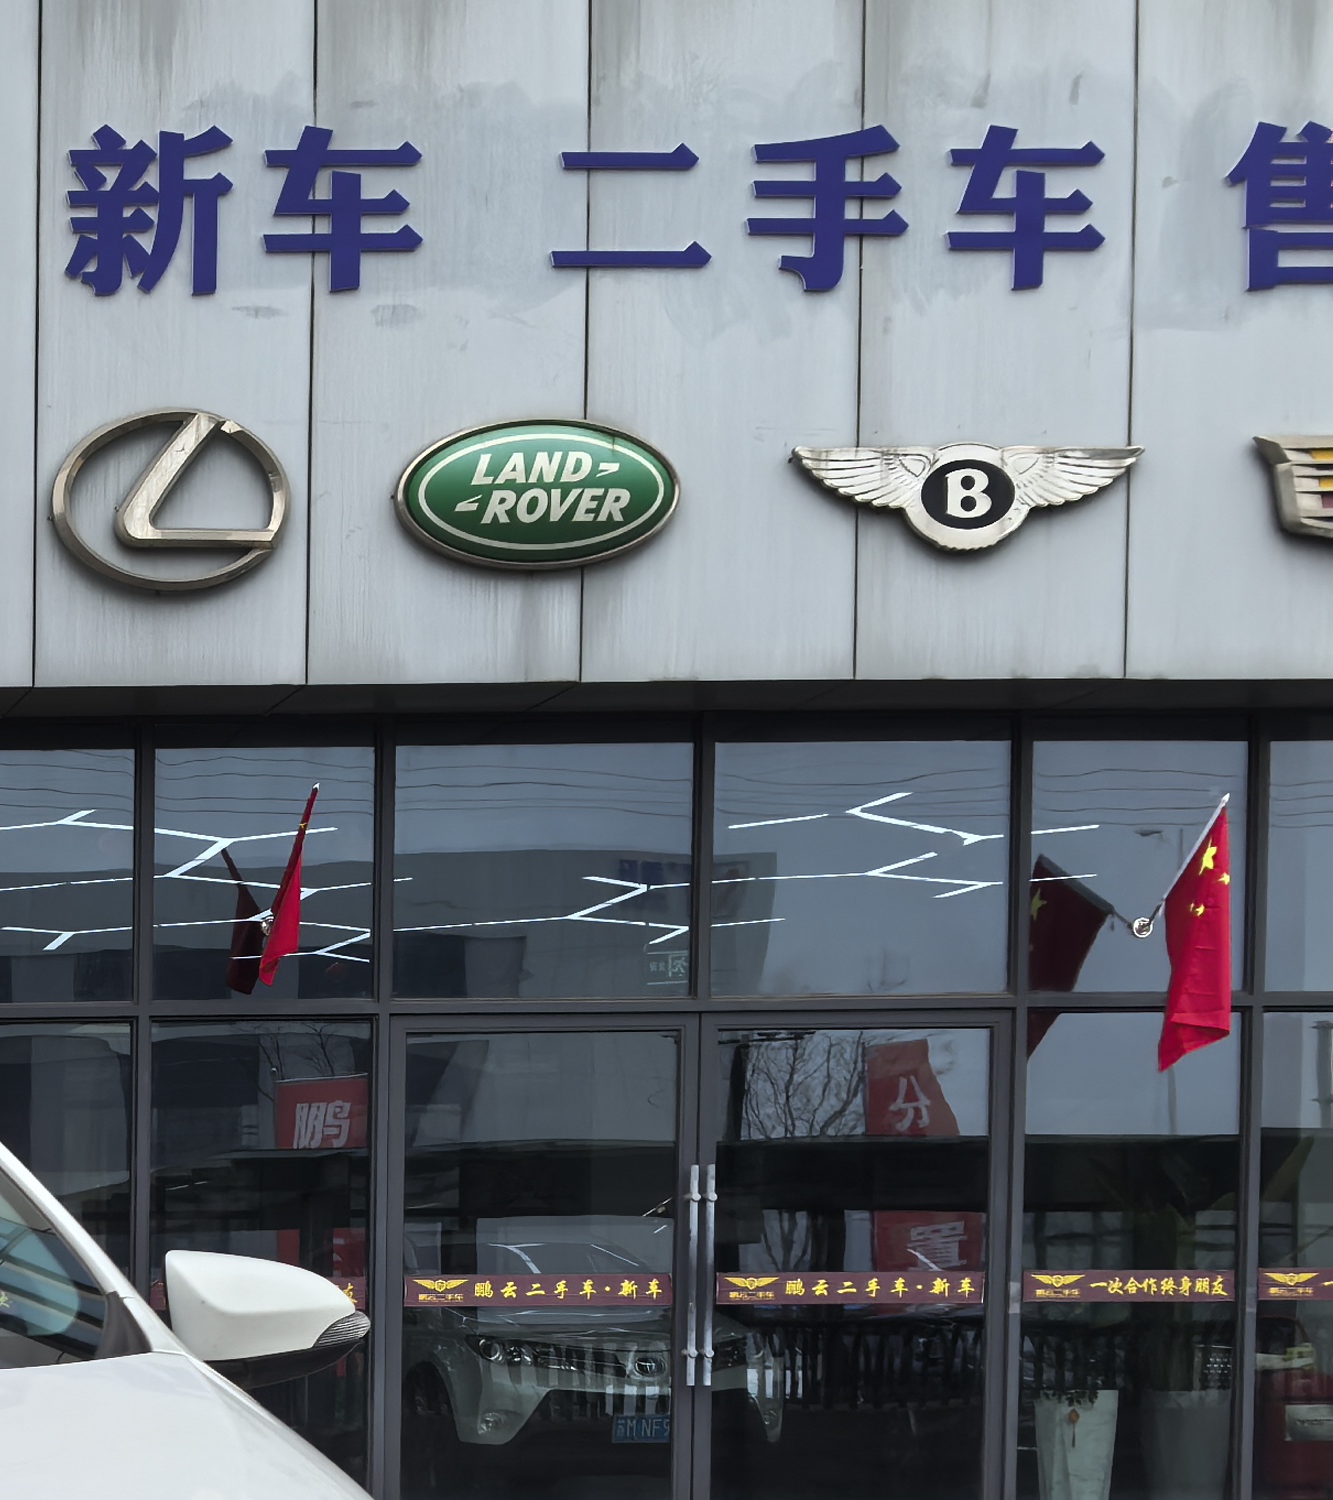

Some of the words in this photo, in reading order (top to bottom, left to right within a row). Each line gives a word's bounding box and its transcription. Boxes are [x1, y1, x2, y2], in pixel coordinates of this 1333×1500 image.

[63, 124, 423, 296] 新车
[549, 124, 1107, 293] 二手车
[470, 451, 593, 486] LAND
[480, 487, 631, 524] ROVER
